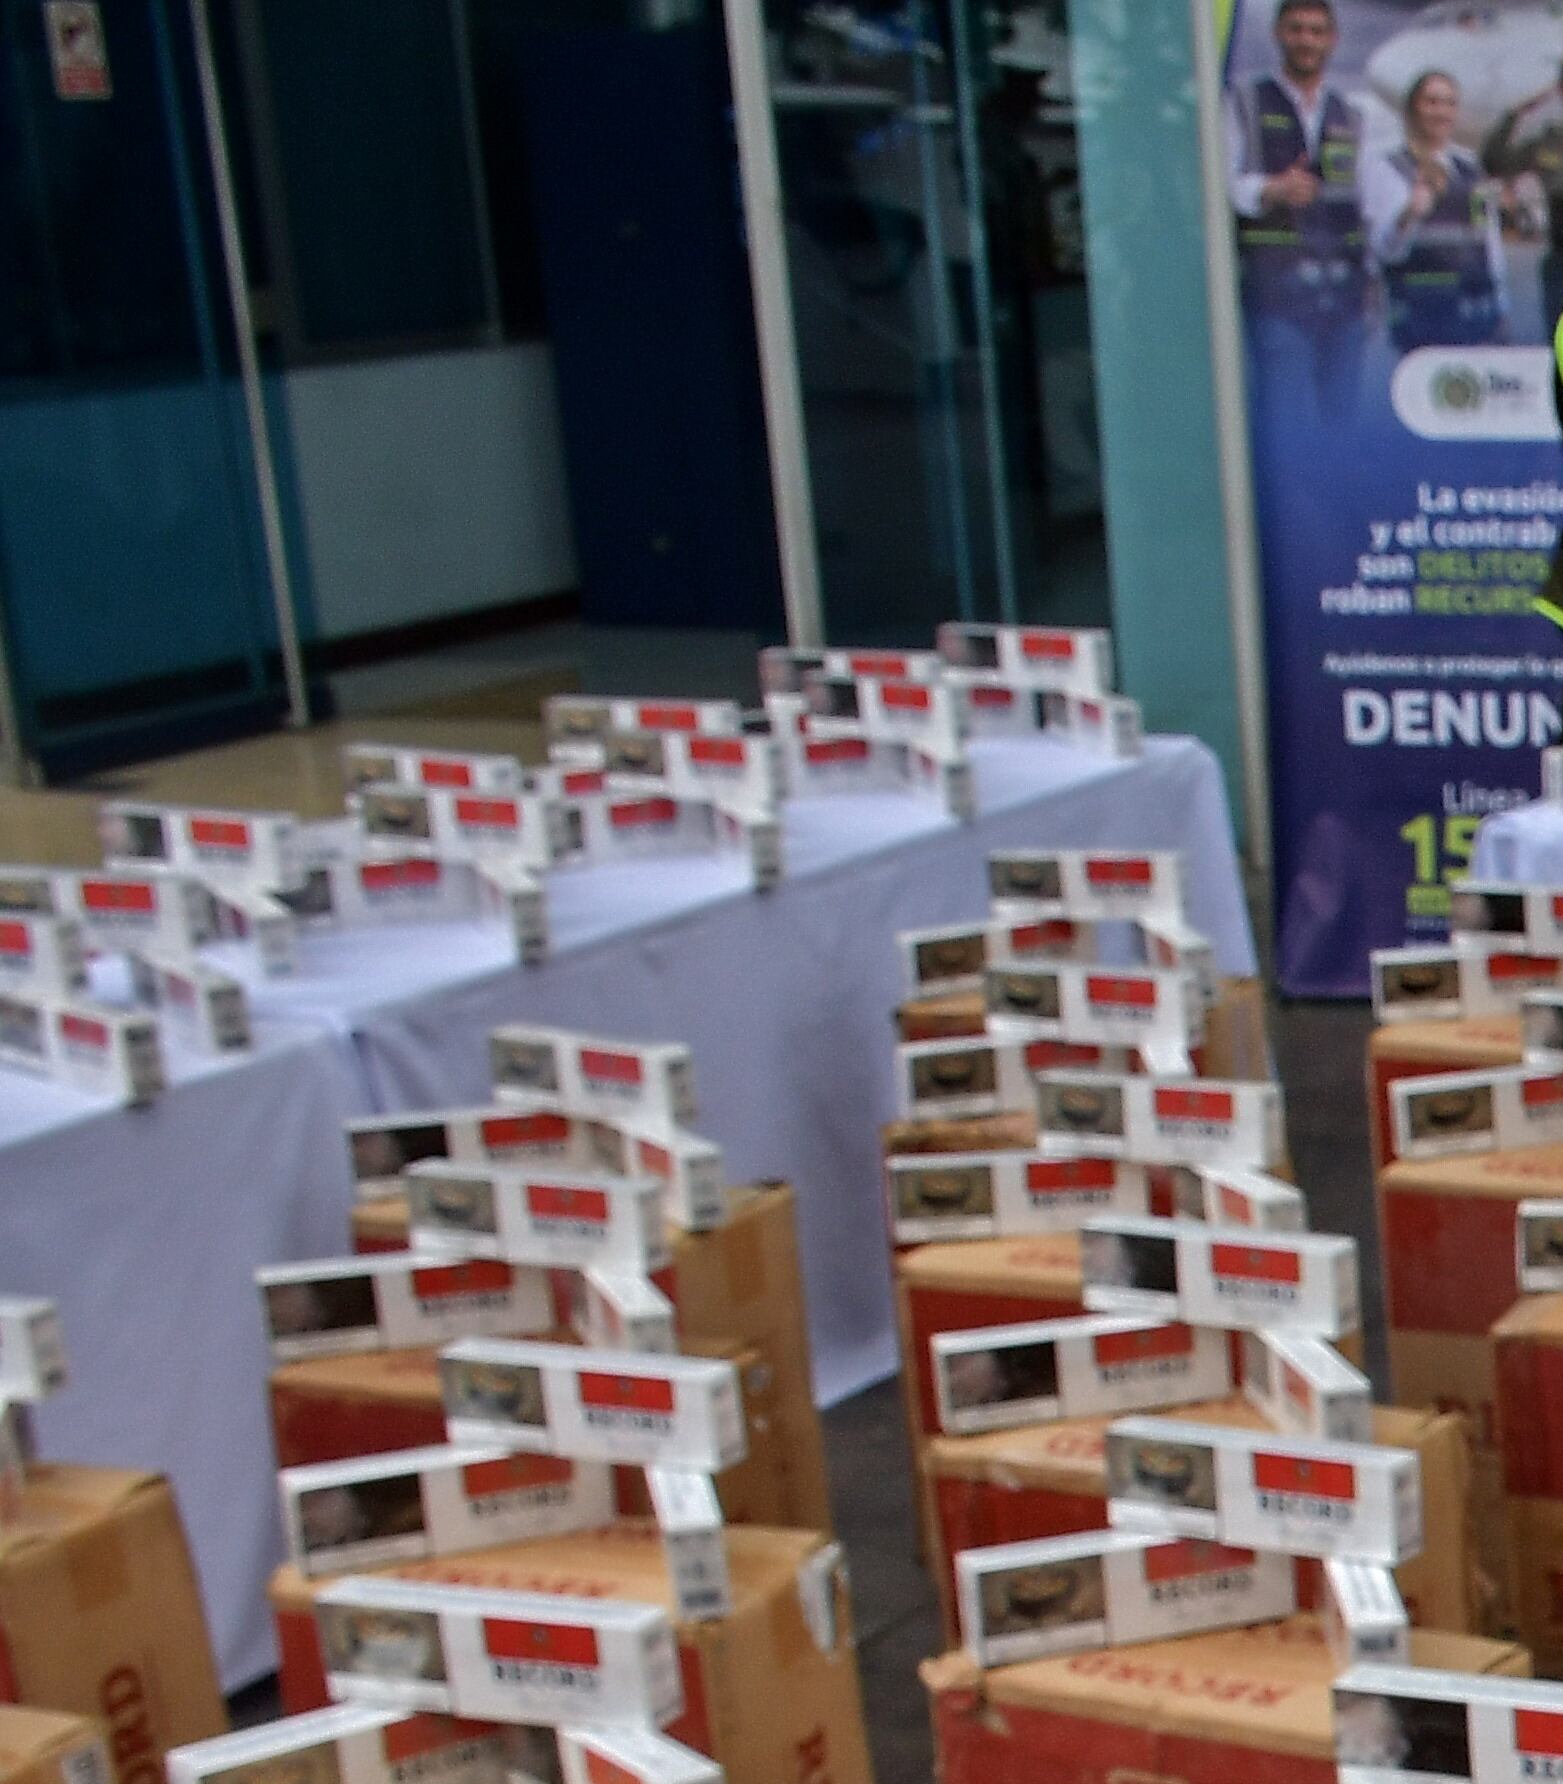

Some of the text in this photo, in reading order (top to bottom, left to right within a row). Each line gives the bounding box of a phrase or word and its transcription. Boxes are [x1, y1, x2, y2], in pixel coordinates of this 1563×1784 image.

[1417, 482, 1457, 513] La
[1370, 514, 1557, 551] y el contrab
[1358, 553, 1414, 580] son
[1342, 687, 1563, 746] DENUN
[1400, 814, 1481, 884] 15
